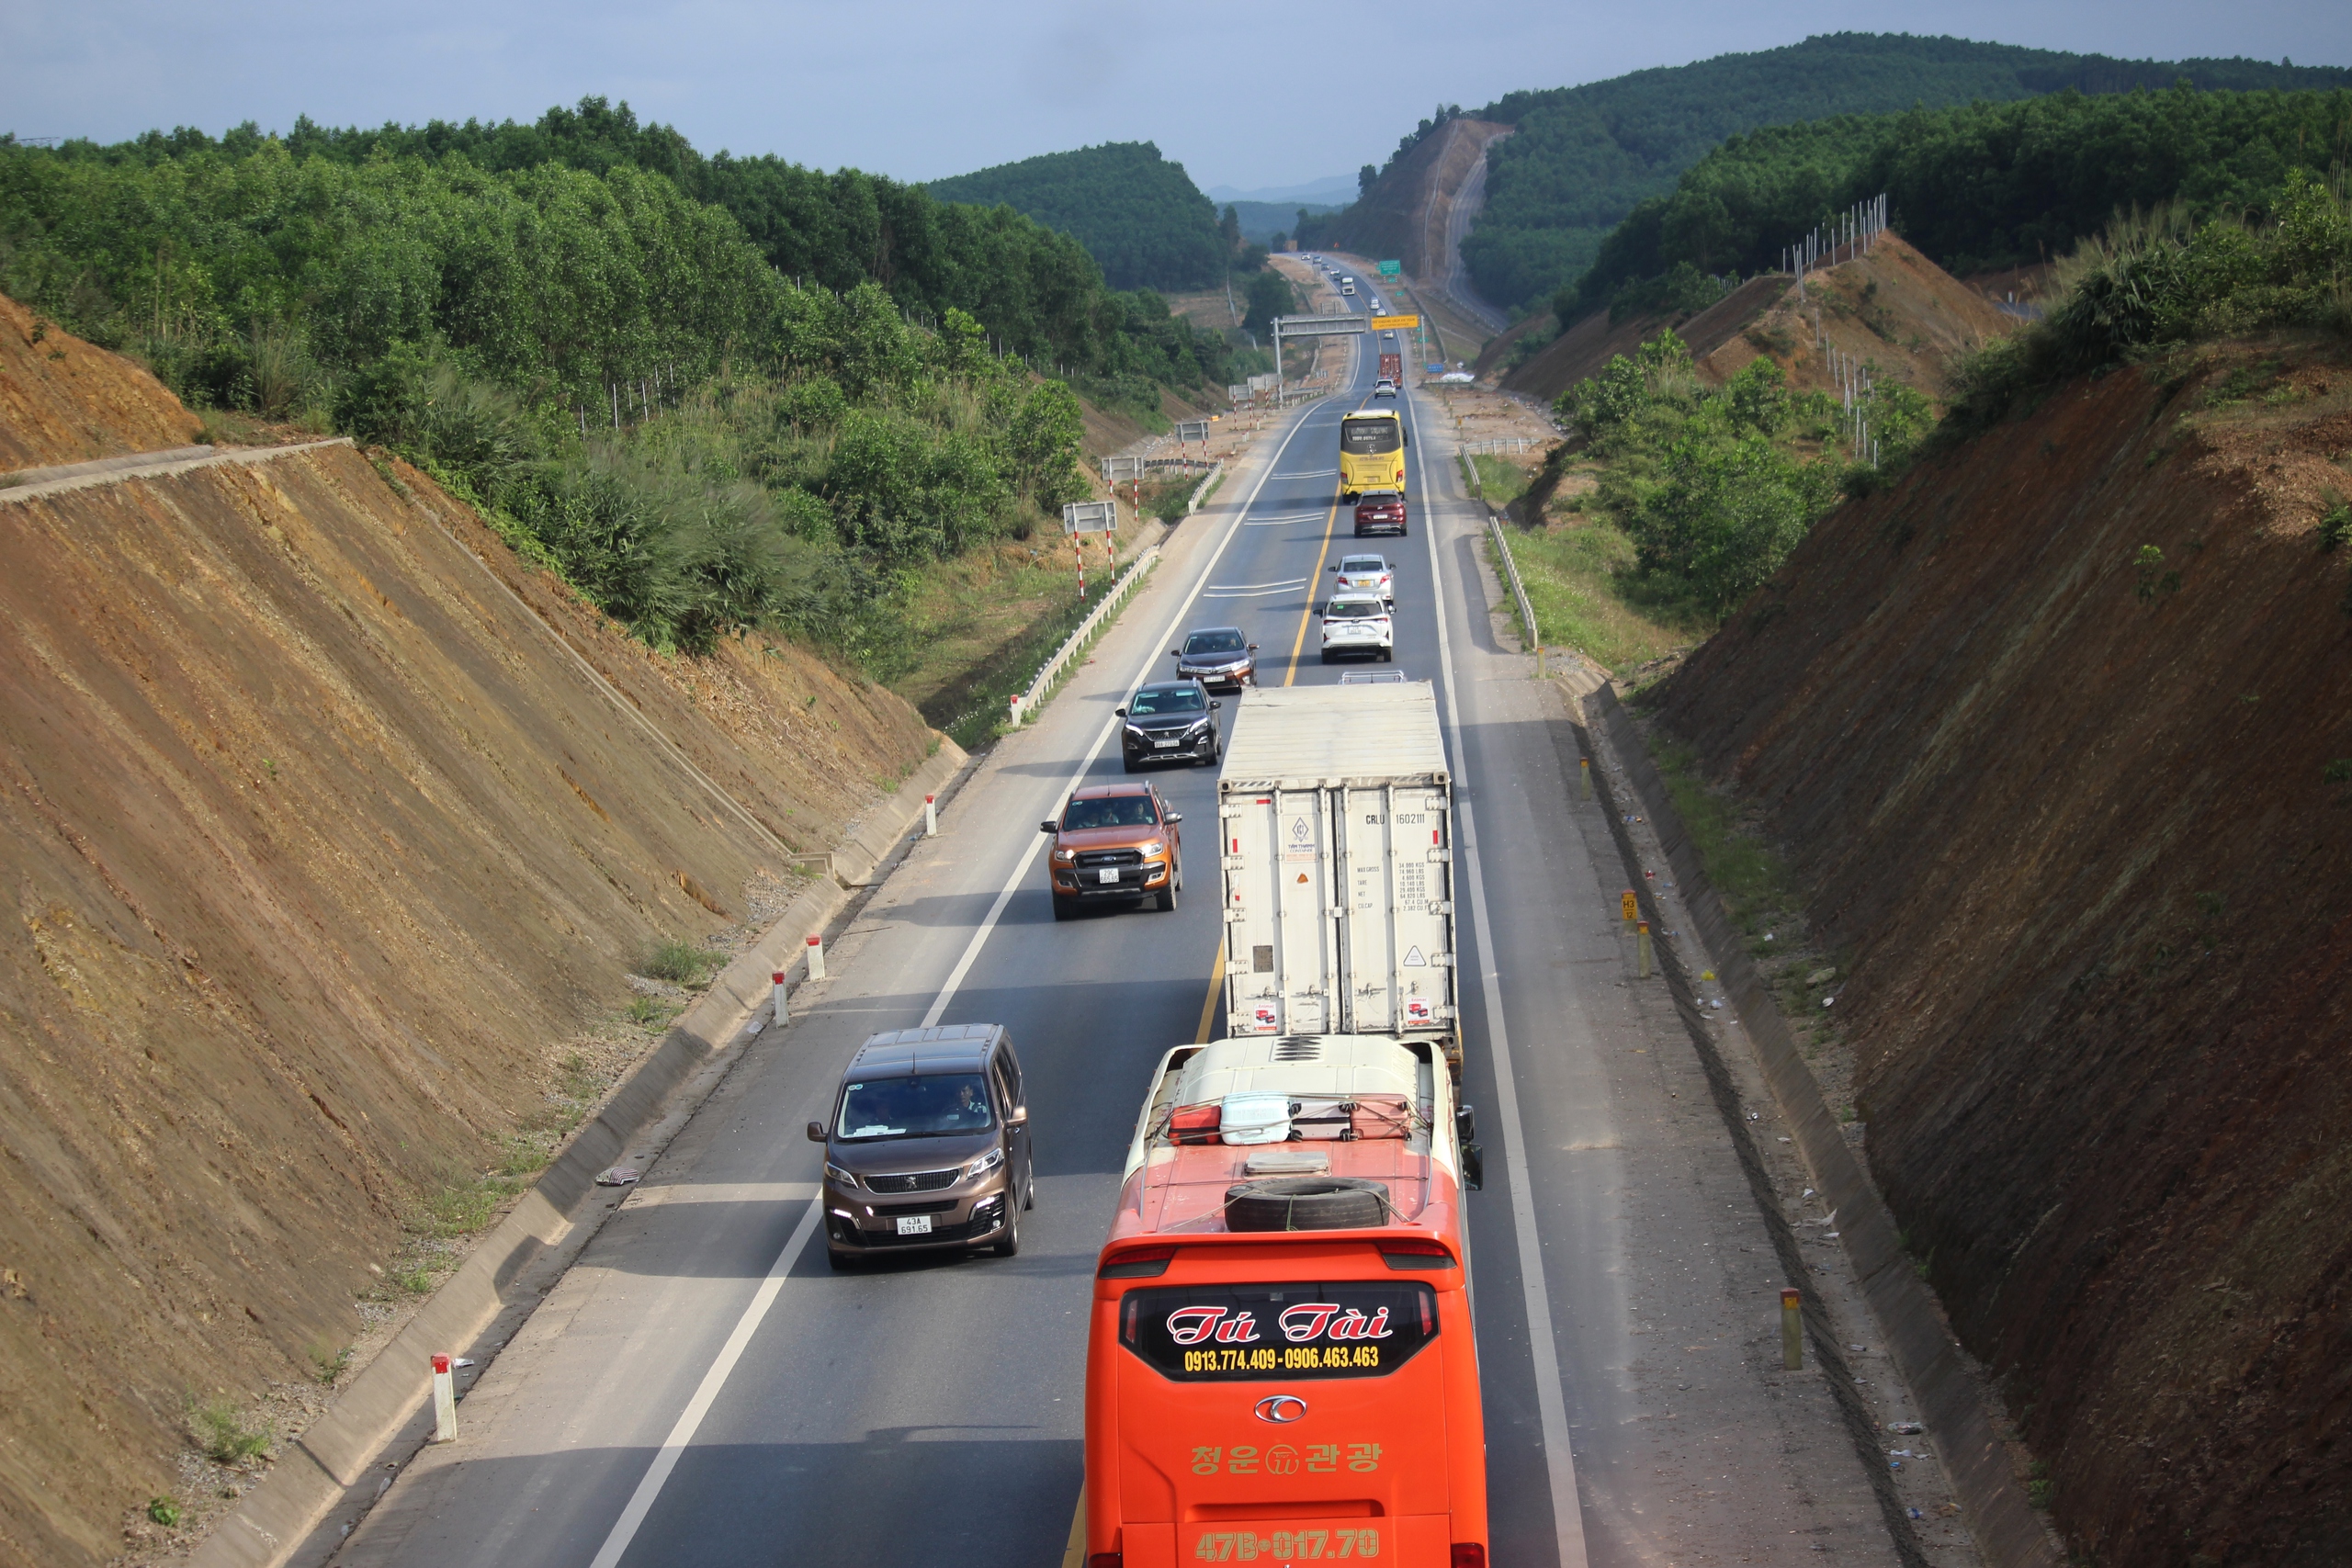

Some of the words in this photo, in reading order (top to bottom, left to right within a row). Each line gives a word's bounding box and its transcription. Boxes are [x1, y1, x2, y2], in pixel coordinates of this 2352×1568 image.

[1365, 814, 1385, 825] CRLU
[1396, 813, 1425, 824] 1602111
[901, 1224, 928, 1234] 691.65
[1166, 1305, 1261, 1345] Tú
[1278, 1302, 1394, 1343] Tài
